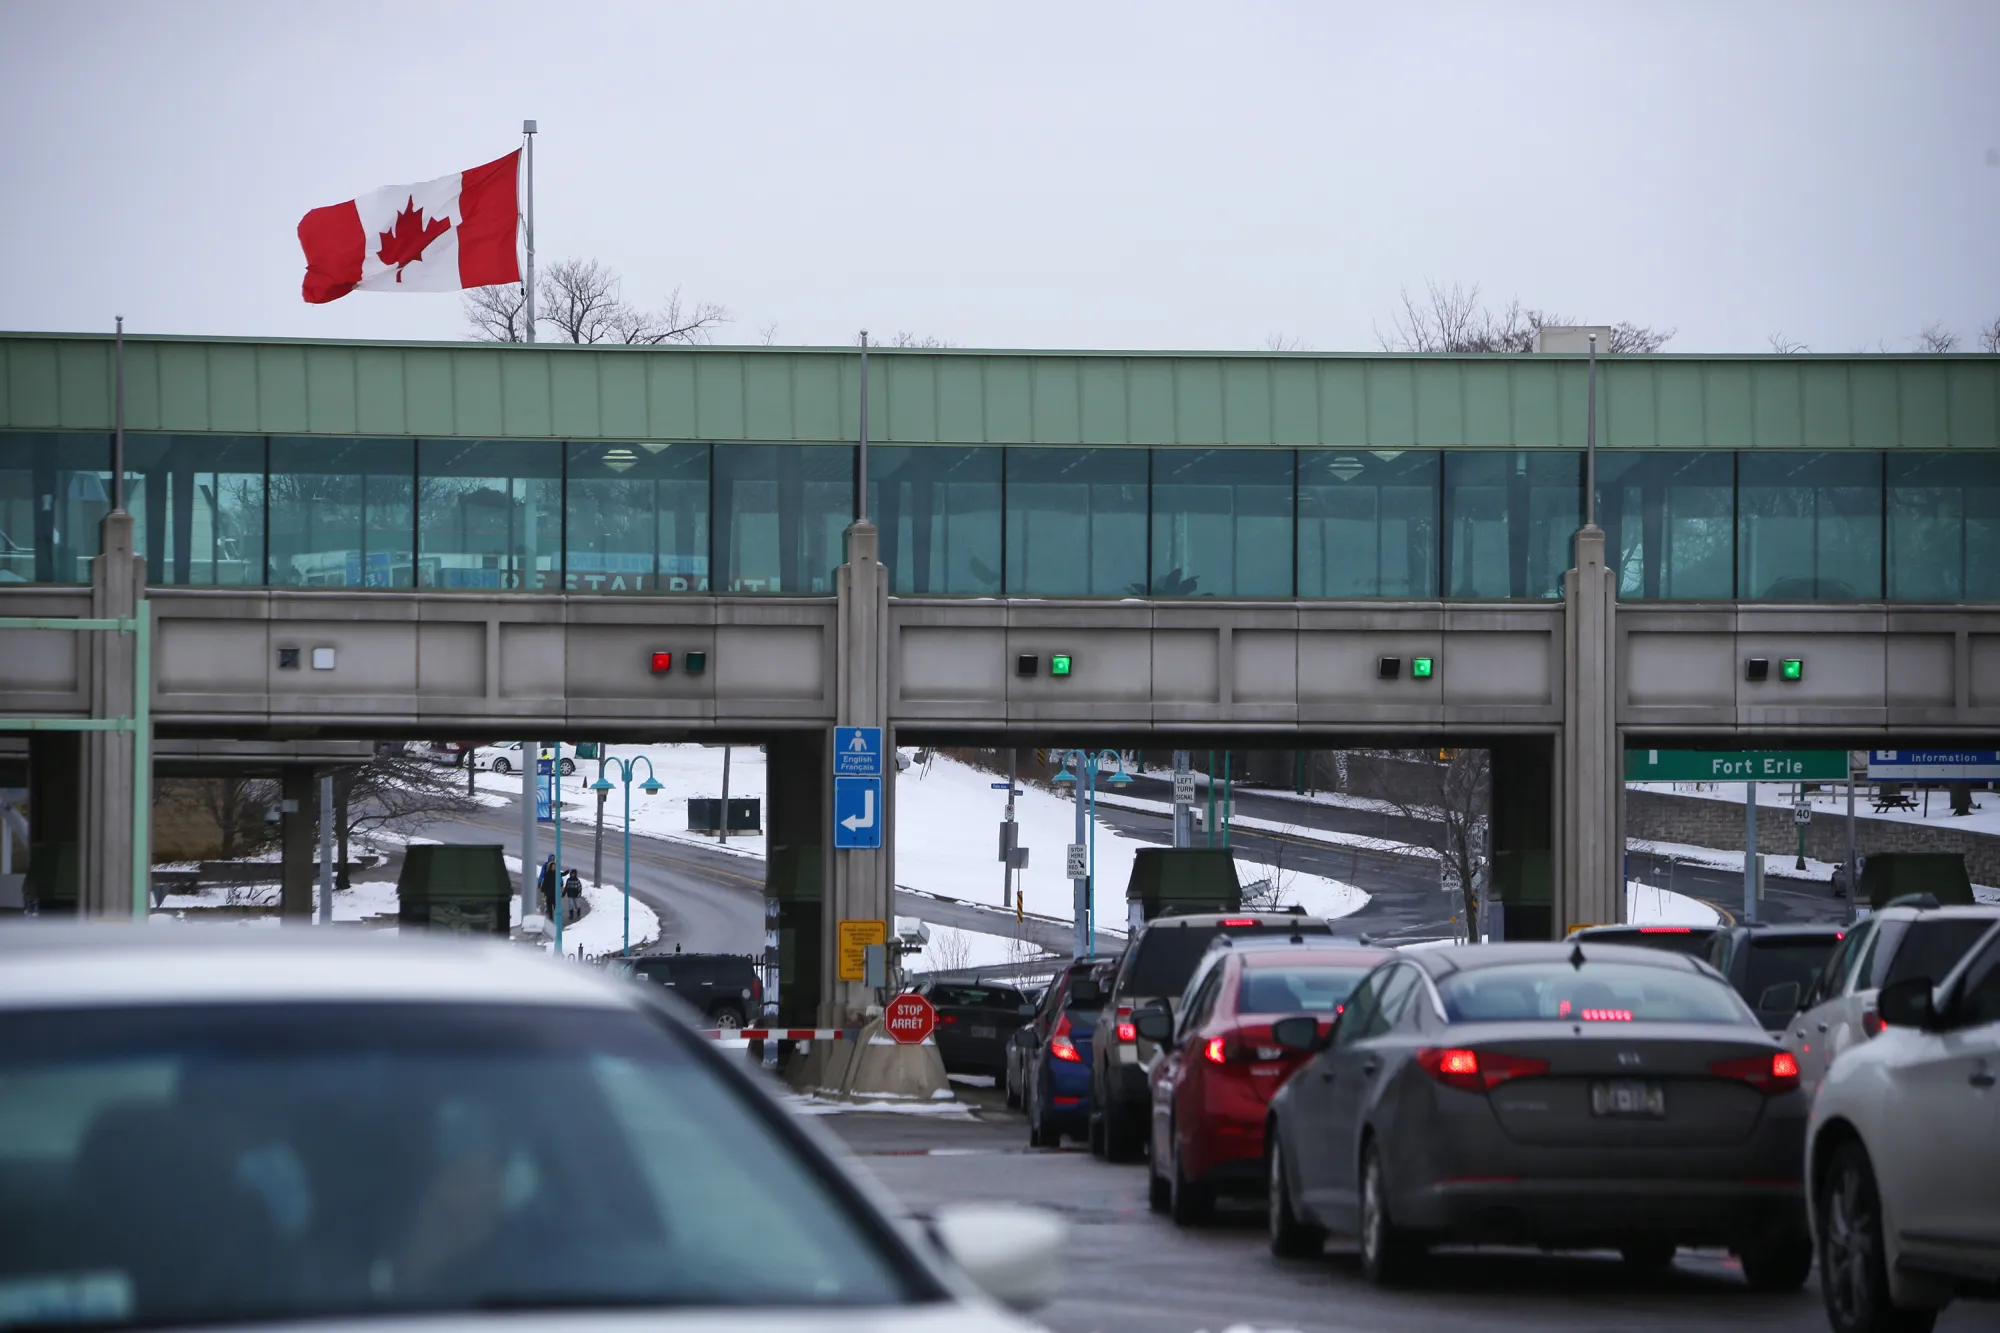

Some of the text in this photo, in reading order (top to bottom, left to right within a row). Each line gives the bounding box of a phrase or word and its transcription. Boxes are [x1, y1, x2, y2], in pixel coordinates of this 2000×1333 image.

[500, 572, 765, 591] RESTARAT
[843, 755, 873, 764] English
[1912, 754, 1977, 762] Information
[840, 763, 875, 771] Français
[1713, 759, 1803, 774] Fort Erie
[1796, 809, 1810, 819] 40
[897, 1004, 923, 1016] STOP
[891, 1017, 924, 1029] ARRÊT
